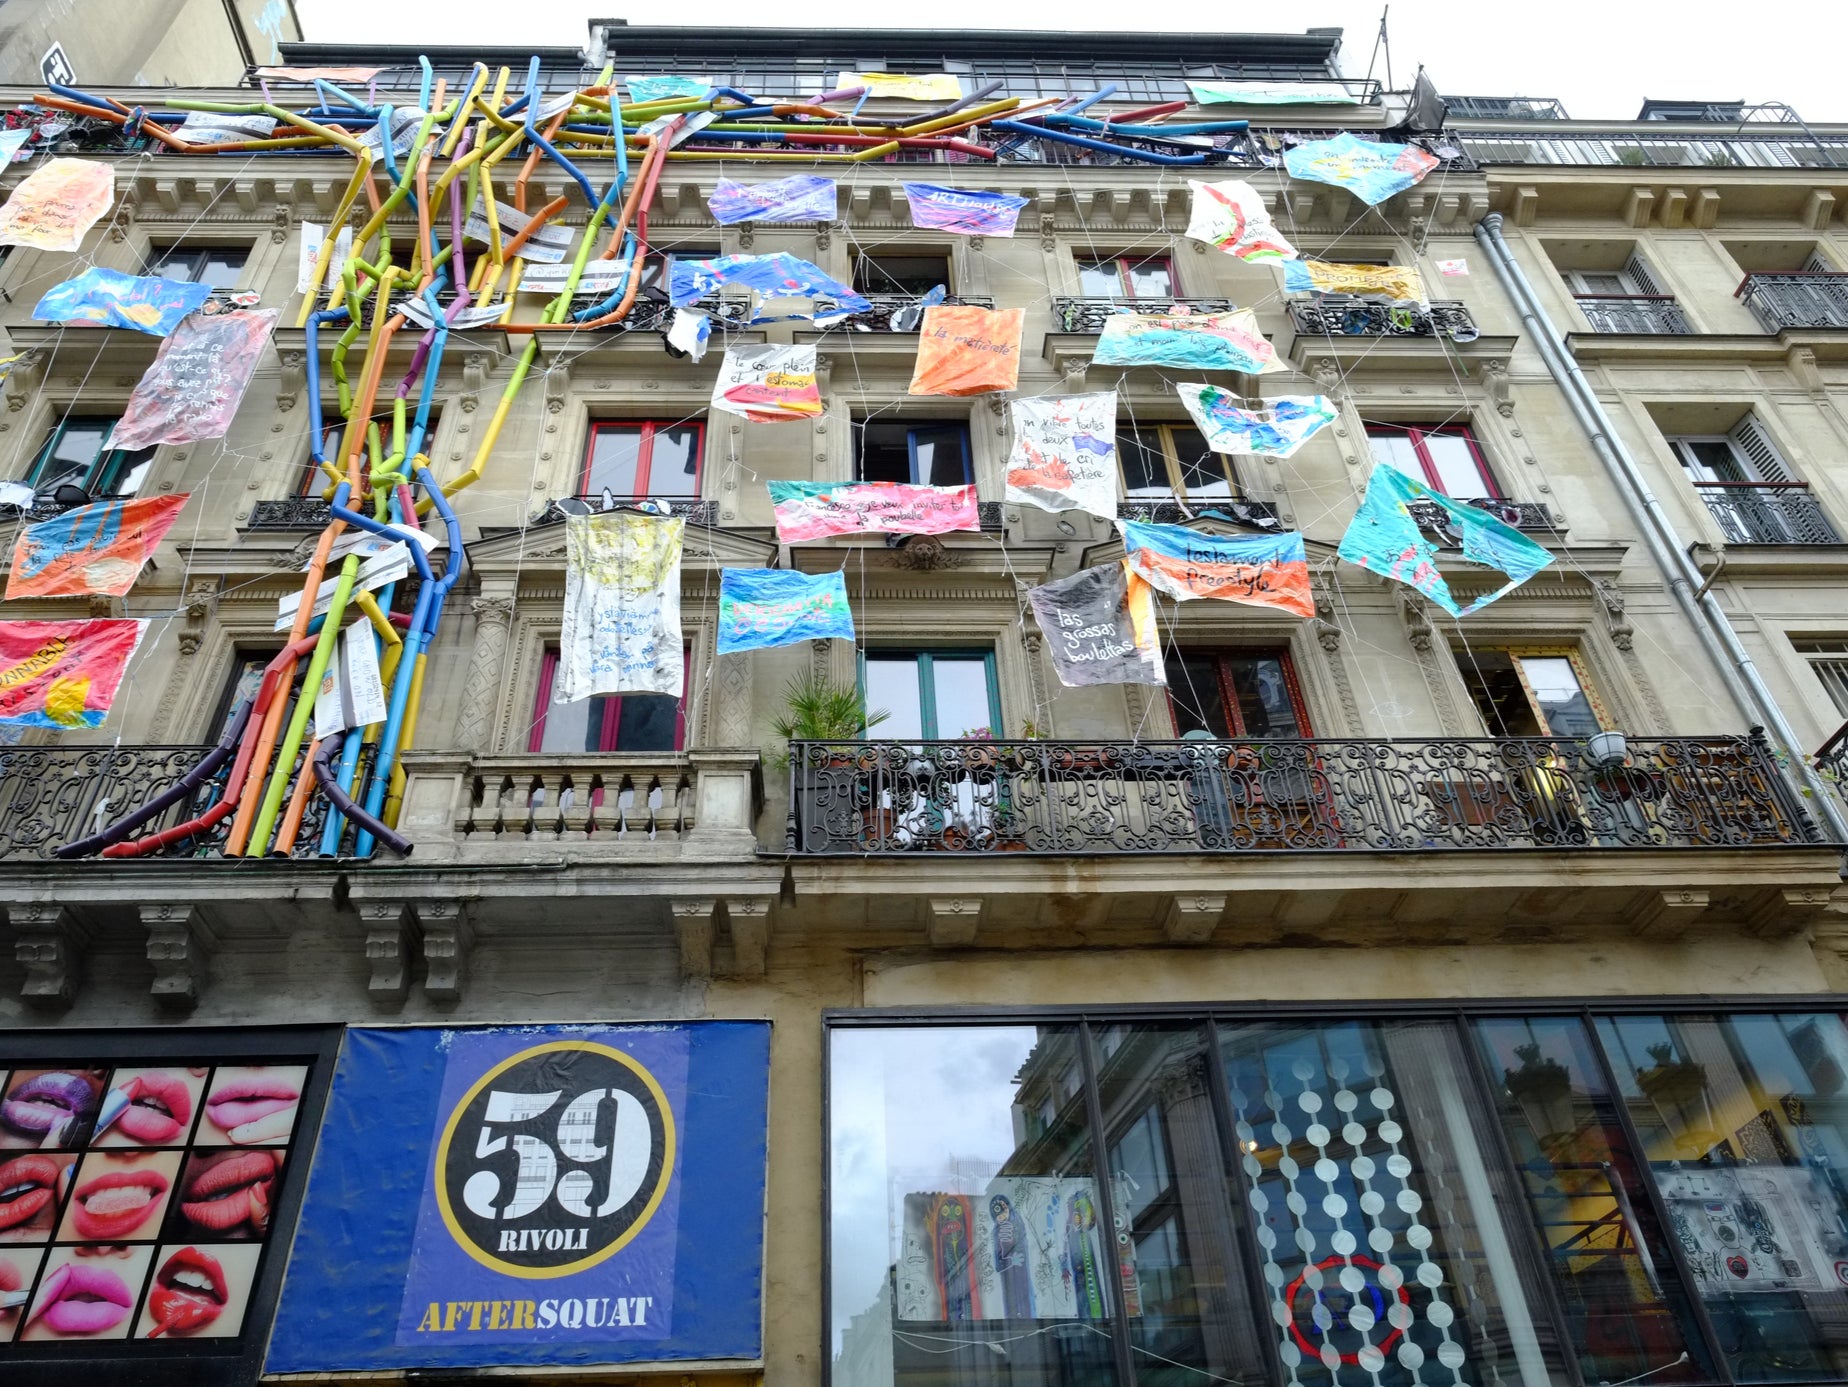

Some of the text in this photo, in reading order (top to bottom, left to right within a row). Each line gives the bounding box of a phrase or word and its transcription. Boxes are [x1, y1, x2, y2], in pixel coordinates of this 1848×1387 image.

[934, 326, 947, 338] la
[783, 358, 810, 374] plein
[1056, 608, 1084, 628] las
[1062, 622, 1116, 649] grossas
[1063, 638, 1135, 663] boulettas
[462, 1087, 652, 1220] 59
[497, 1228, 590, 1252] RIVOLI
[416, 1296, 653, 1333] AFTERSQUAT
